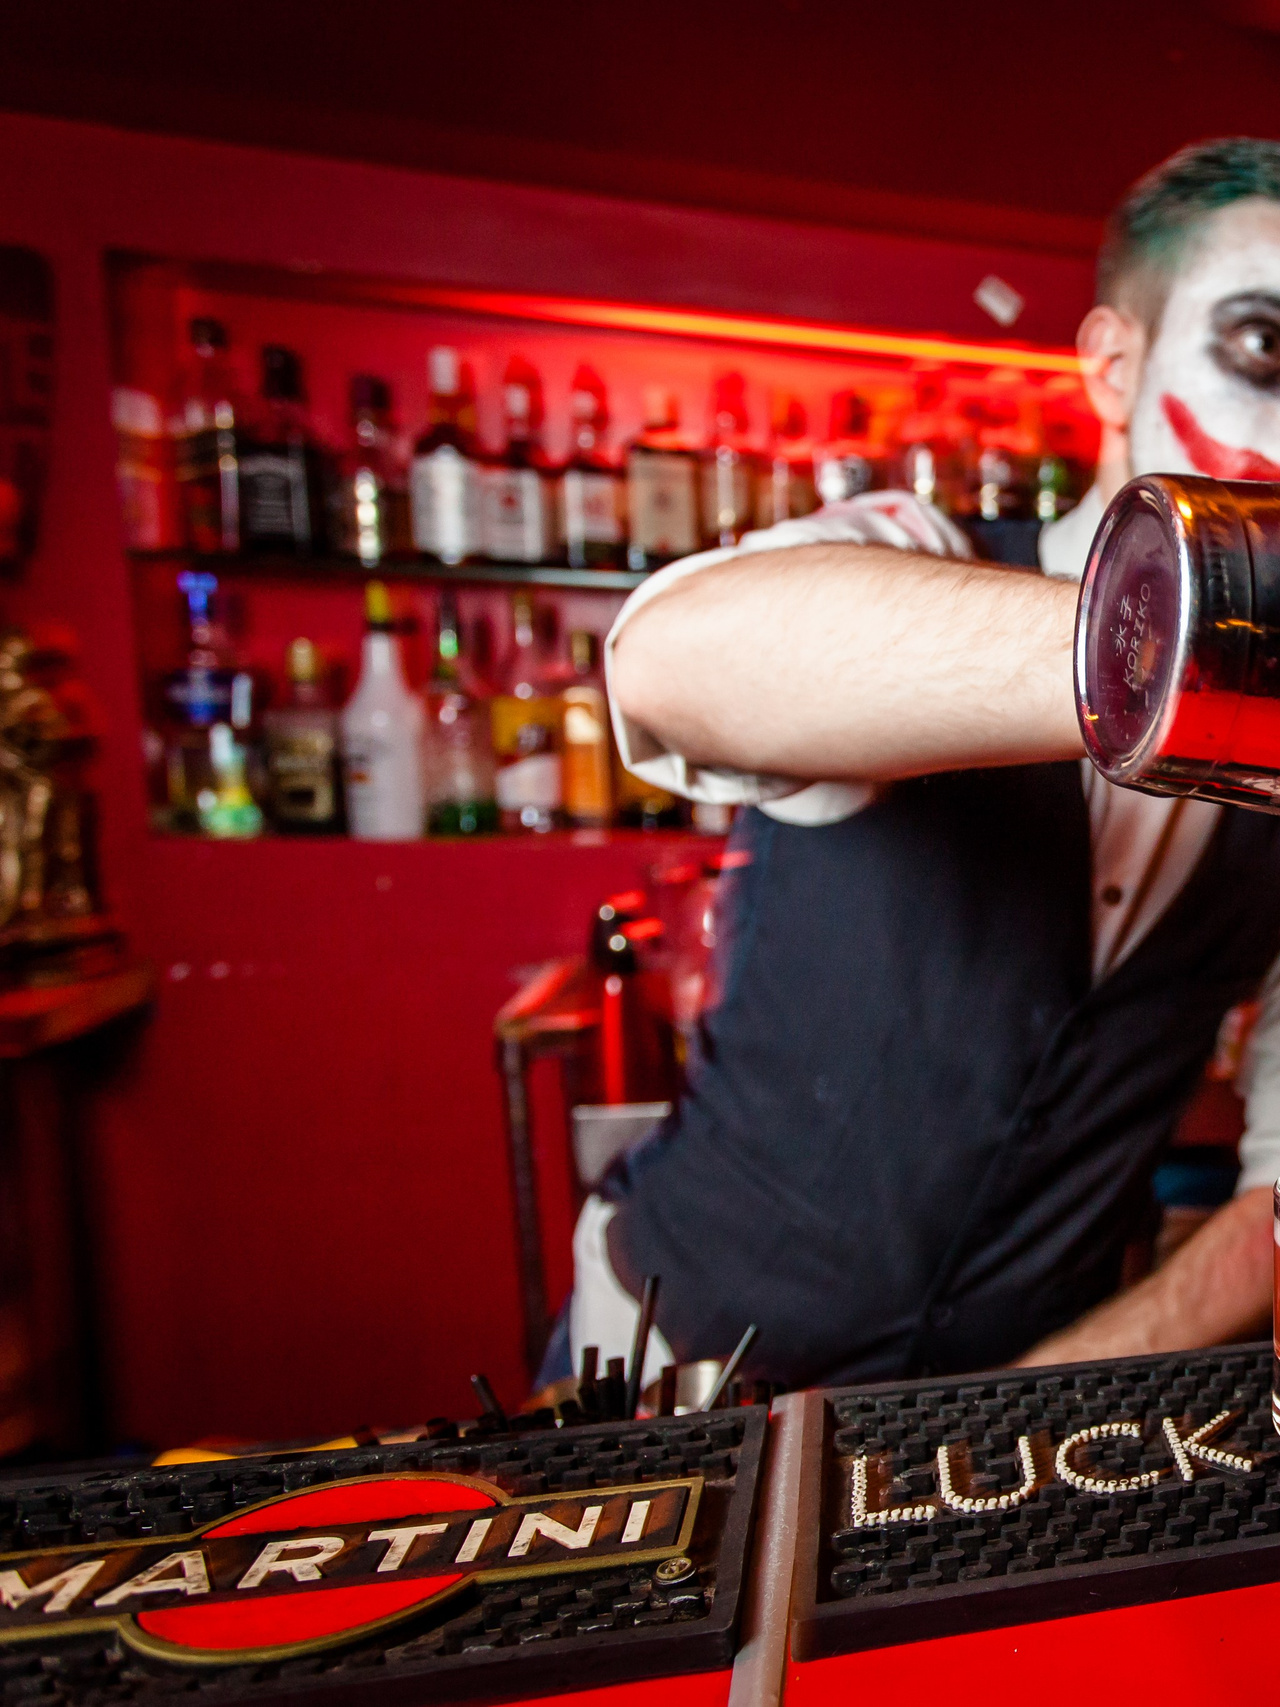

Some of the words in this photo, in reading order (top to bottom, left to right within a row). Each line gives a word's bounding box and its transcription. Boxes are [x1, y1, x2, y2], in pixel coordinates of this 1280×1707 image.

[1124, 583, 1151, 688] KORIKO
[852, 1410, 1253, 1528] LUCK
[0, 1500, 651, 1614] MARTINI
